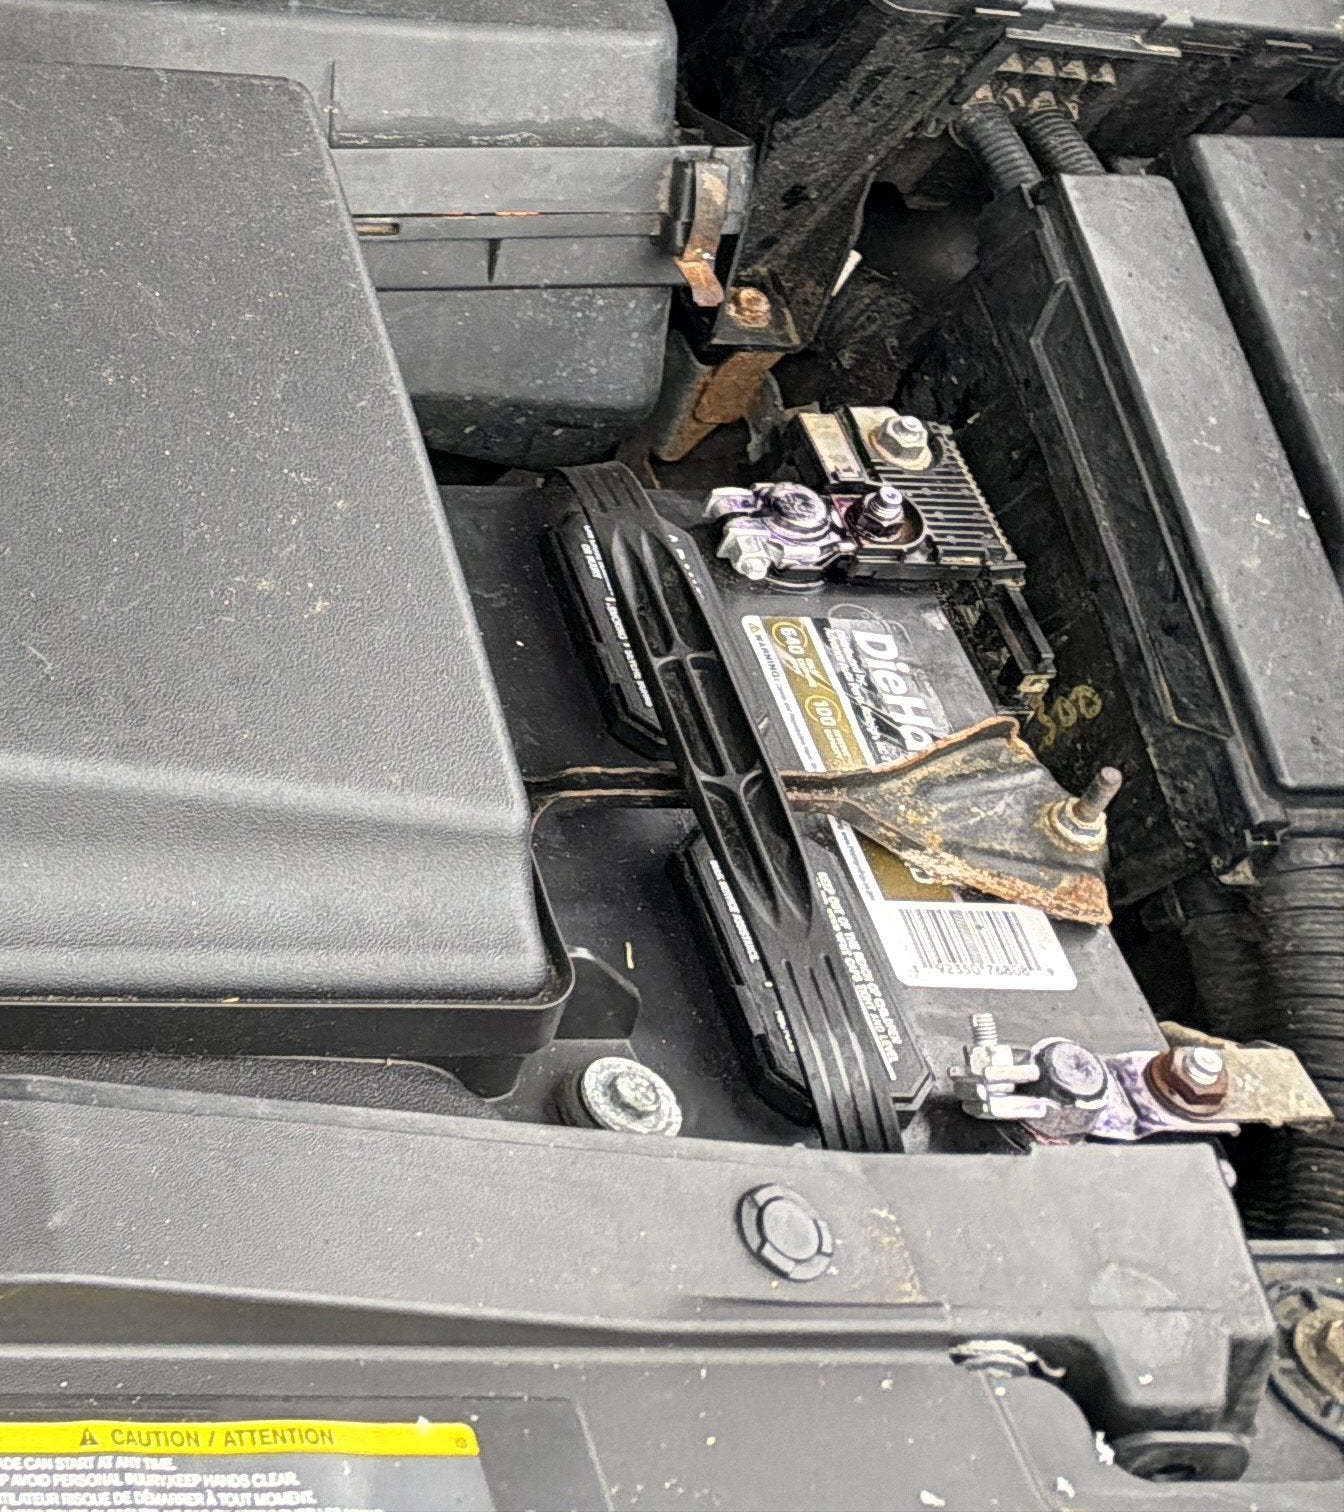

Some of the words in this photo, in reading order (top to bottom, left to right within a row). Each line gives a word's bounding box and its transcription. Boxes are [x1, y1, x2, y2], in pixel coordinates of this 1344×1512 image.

[780, 628, 805, 655] 640
[852, 630, 937, 751] DieHa
[813, 700, 836, 726] 100
[869, 1013, 886, 1032] AND
[110, 1429, 200, 1448] CAUTION
[208, 1431, 215, 1447] /
[224, 1428, 334, 1447] ATTENTION
[23, 1456, 53, 1471] CAN
[54, 1456, 95, 1471] START
[97, 1455, 113, 1469] AT
[115, 1456, 142, 1470] ANY
[11, 1473, 51, 1487] AVOID
[53, 1473, 124, 1487] PERSONAL
[203, 1473, 250, 1488] HANDS
[251, 1472, 301, 1488] CLEAR.
[62, 1492, 111, 1506] RISQUE
[113, 1491, 132, 1506] DE
[134, 1489, 205, 1506] DÉMARRER
[217, 1492, 252, 1506] TOUT
